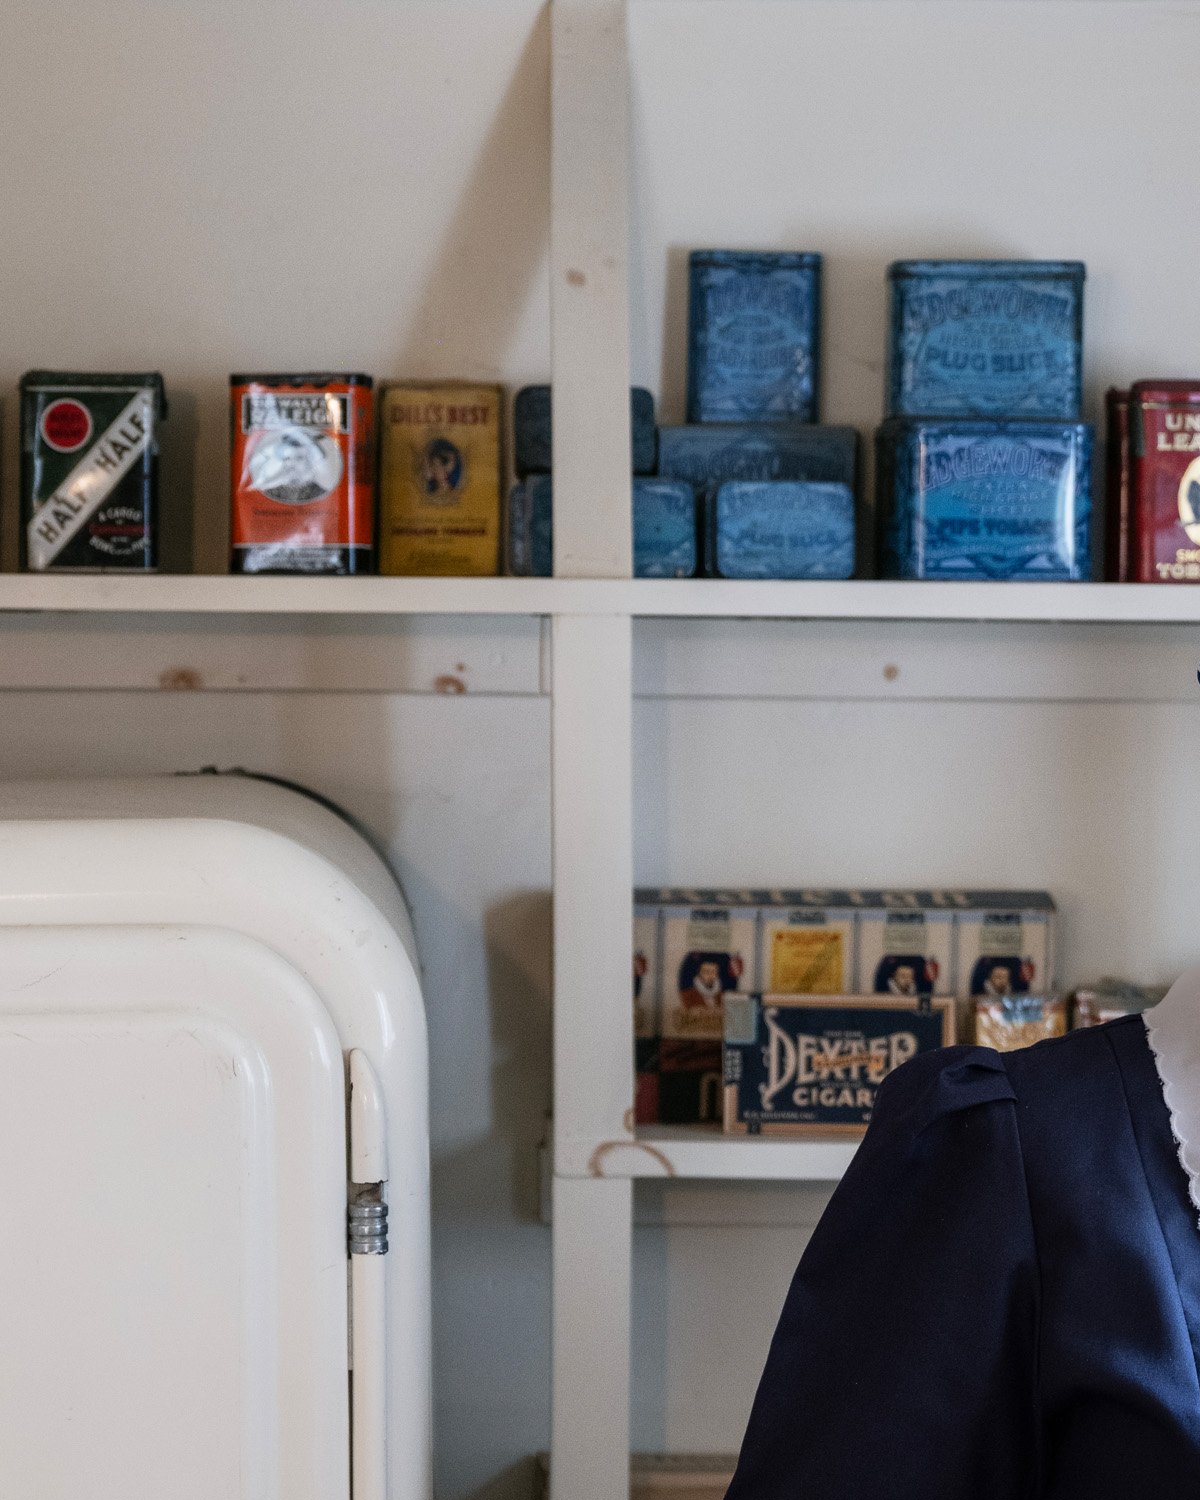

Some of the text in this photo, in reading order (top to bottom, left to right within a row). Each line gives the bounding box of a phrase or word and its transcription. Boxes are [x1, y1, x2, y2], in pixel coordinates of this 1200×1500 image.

[925, 346, 986, 372] PLUG
[446, 405, 490, 426] BEST
[757, 1006, 919, 1112] DEXTER
[791, 1086, 877, 1109] CIGAR
